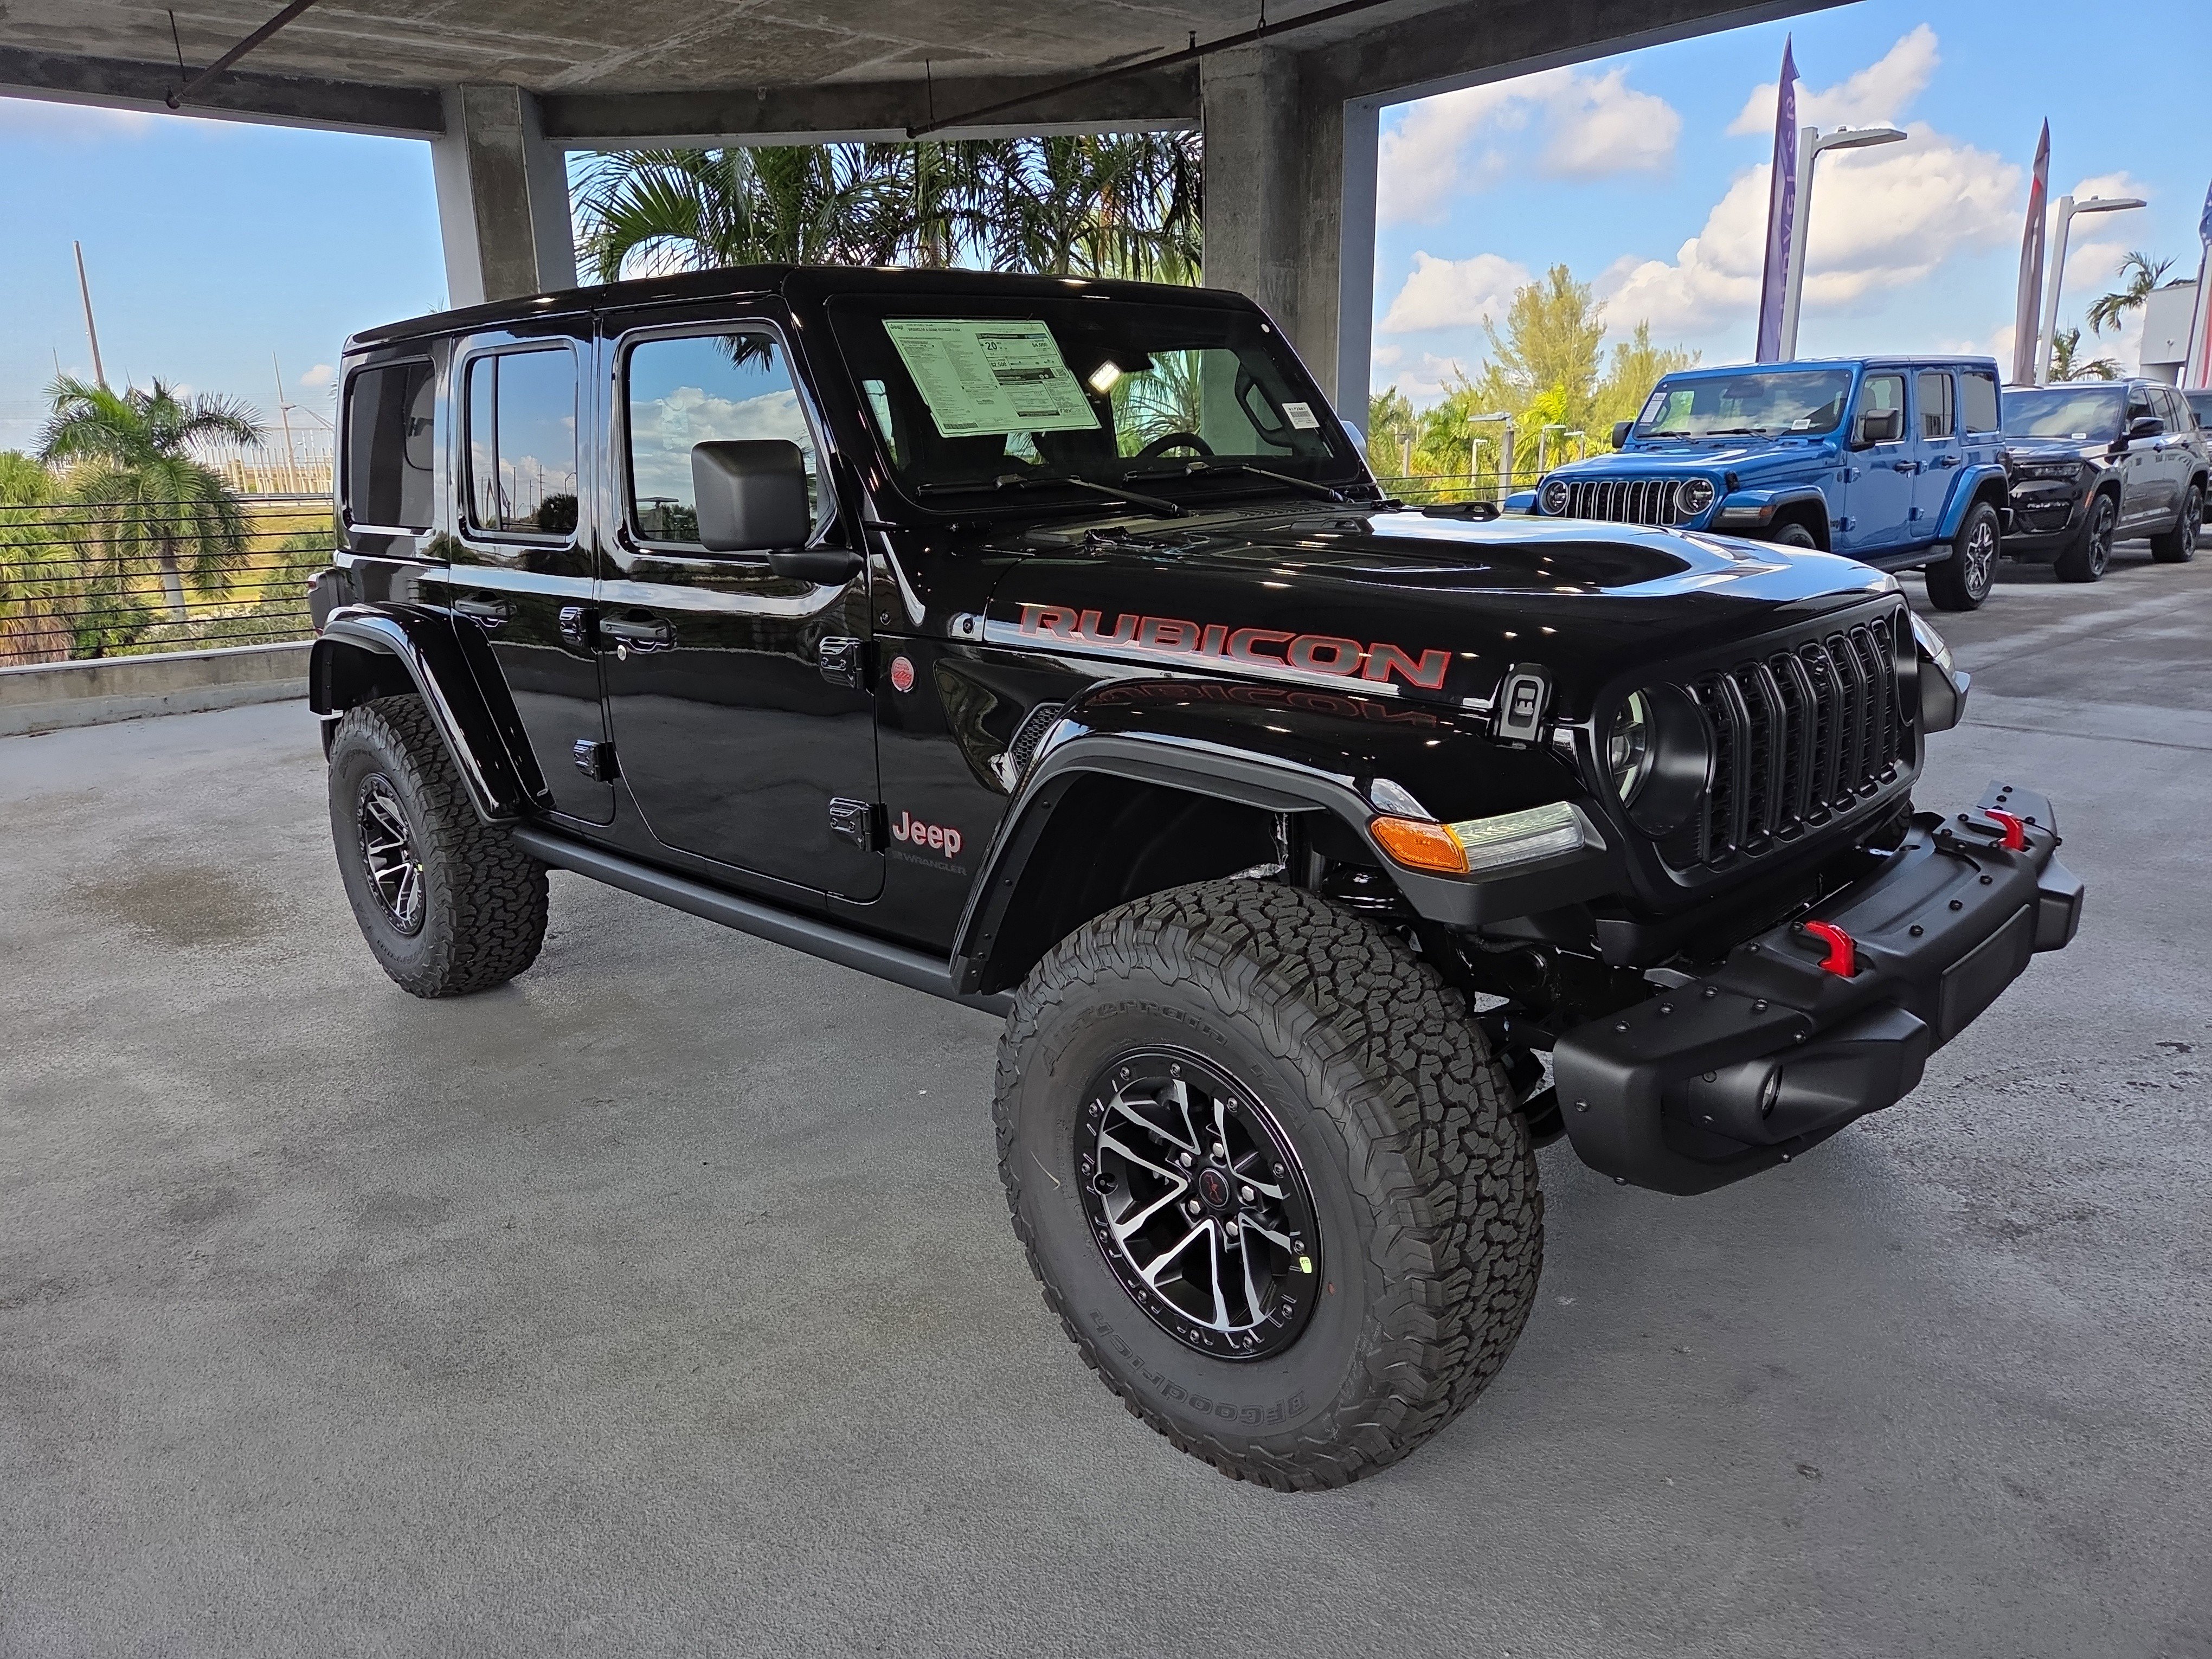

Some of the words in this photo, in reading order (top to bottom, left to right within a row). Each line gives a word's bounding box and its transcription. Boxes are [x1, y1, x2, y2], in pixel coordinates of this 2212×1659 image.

[985, 341, 998, 351] 20
[1019, 606, 1451, 689] RUBICON
[892, 811, 961, 859] Jeep
[902, 852, 968, 877] WRANGLER
[1042, 999, 1229, 1077] All-Terrain
[1089, 1308, 1310, 1426] BFGoodrich
